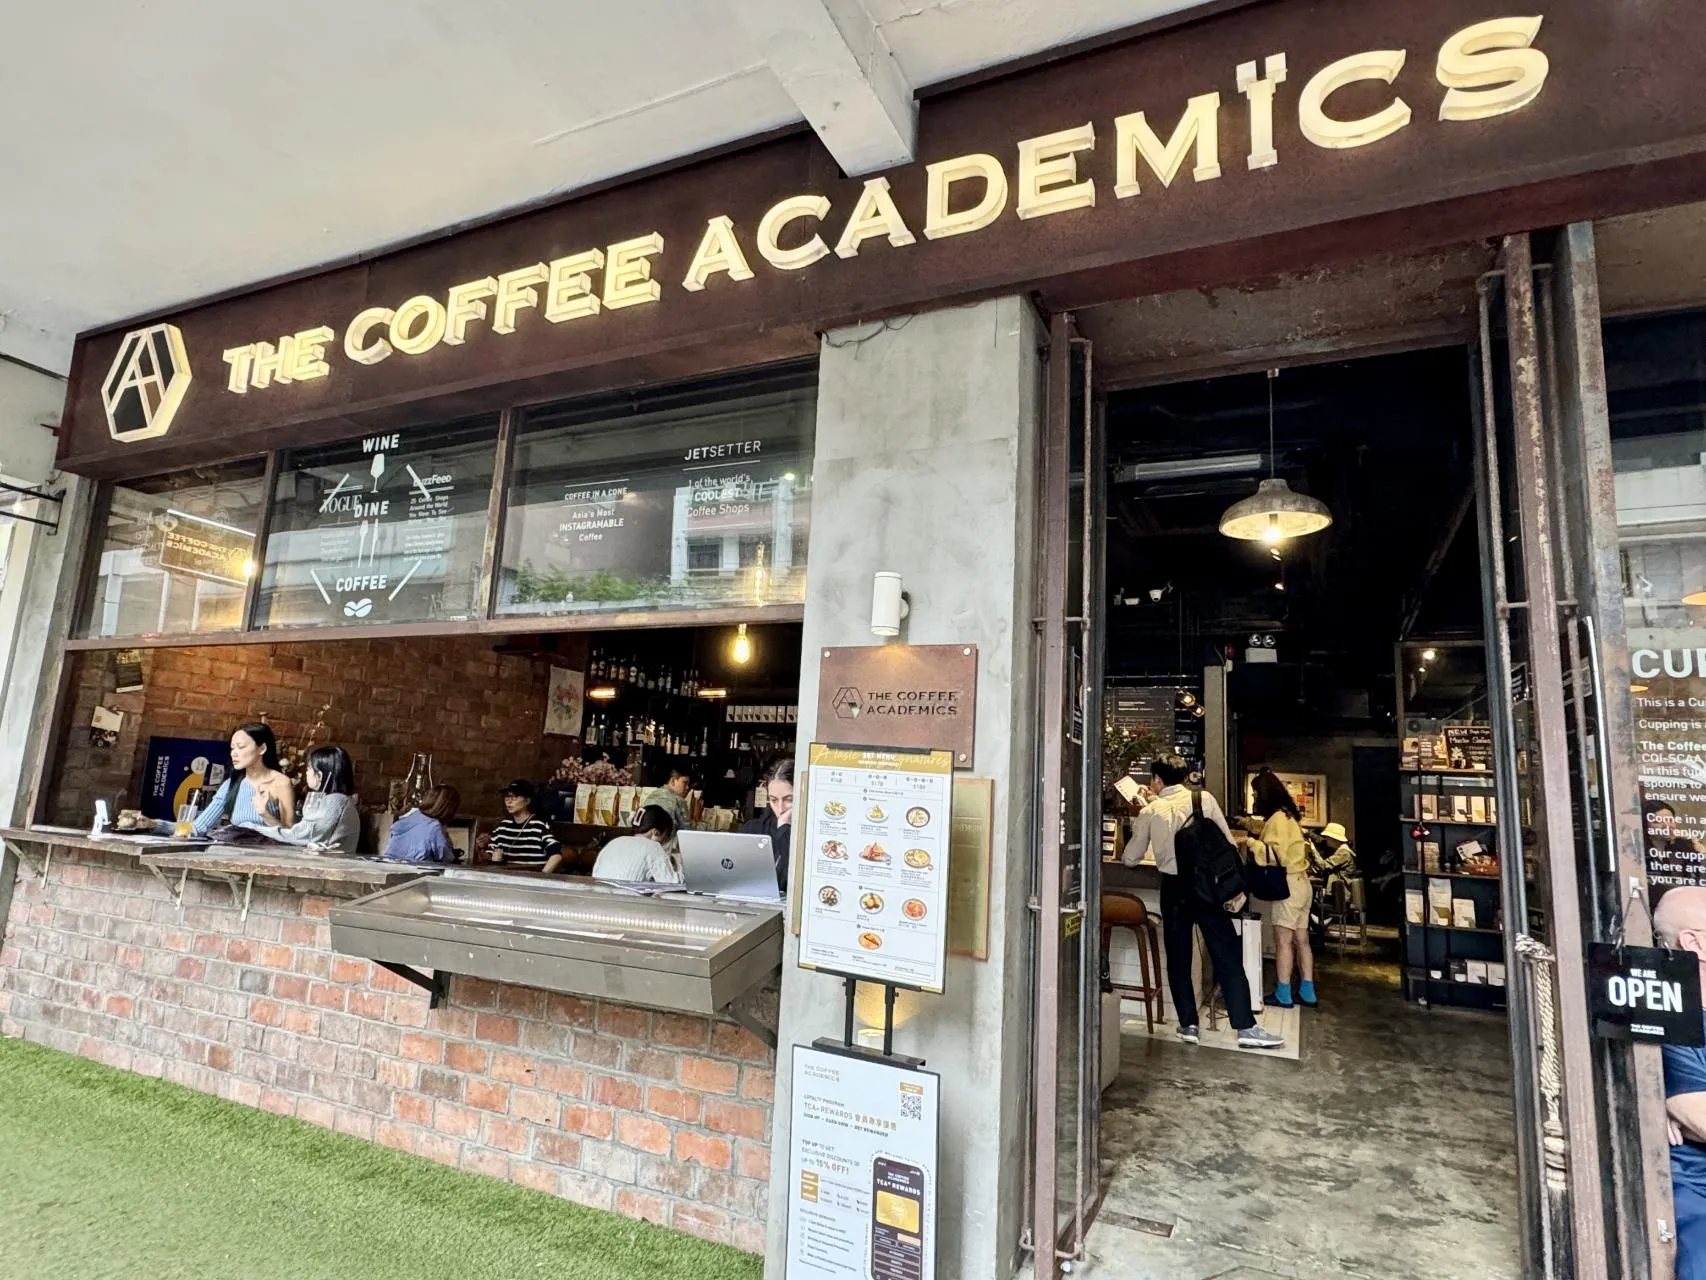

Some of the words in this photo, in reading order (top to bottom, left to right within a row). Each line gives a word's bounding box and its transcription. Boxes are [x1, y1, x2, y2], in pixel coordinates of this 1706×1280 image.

[223, 326, 334, 394] THE
[344, 231, 664, 366] COFFEE
[362, 434, 400, 453] WINE
[684, 440, 761, 461] JETSETTER
[695, 477, 704, 489] of
[705, 476, 718, 487] the
[719, 474, 750, 486] world's
[564, 491, 591, 501] COFFEE
[592, 489, 600, 499] IN
[602, 489, 608, 498] A
[608, 487, 628, 497] CONE
[694, 488, 740, 503] COOLEST
[354, 500, 390, 518] DINE
[597, 508, 615, 518] Most
[687, 504, 717, 518] Coffee
[719, 503, 749, 516] Shops
[559, 518, 624, 532] INSTAGRAMABLE
[579, 533, 603, 542] Coffee
[336, 574, 388, 592] COFFEE
[868, 692, 892, 701] THE
[897, 691, 958, 702] COFFEE
[1636, 697, 1661, 707] This
[1664, 697, 1675, 707] is
[1677, 699, 1685, 707] a
[1688, 697, 1706, 707] Cu
[1639, 719, 1688, 731] Cupping
[1691, 719, 1701, 729] is
[1640, 741, 1664, 750] The
[1657, 766, 1679, 775] this
[1644, 780, 1687, 790] spoons
[1691, 779, 1701, 789] to
[1645, 791, 1686, 801] ensure
[1646, 812, 1682, 823] Come
[1685, 814, 1696, 824] in
[1647, 825, 1670, 835] and
[1673, 827, 1705, 840] enjoy
[1649, 848, 1672, 858] Our
[722, 858, 733, 870] hp
[1650, 861, 1682, 872] there
[1685, 864, 1706, 873] are
[1651, 875, 1672, 886] you
[1675, 876, 1695, 885] are
[1630, 968, 1642, 977] WE
[1643, 969, 1657, 979] ARE
[1608, 976, 1683, 1012] OPEN
[820, 1106, 853, 1120] REWARDS
[802, 1138, 811, 1146] TOP
[826, 1151, 853, 1166] DISCOUNTS
[831, 1162, 849, 1175] OFF!
[892, 1181, 921, 1196] REWARDS
